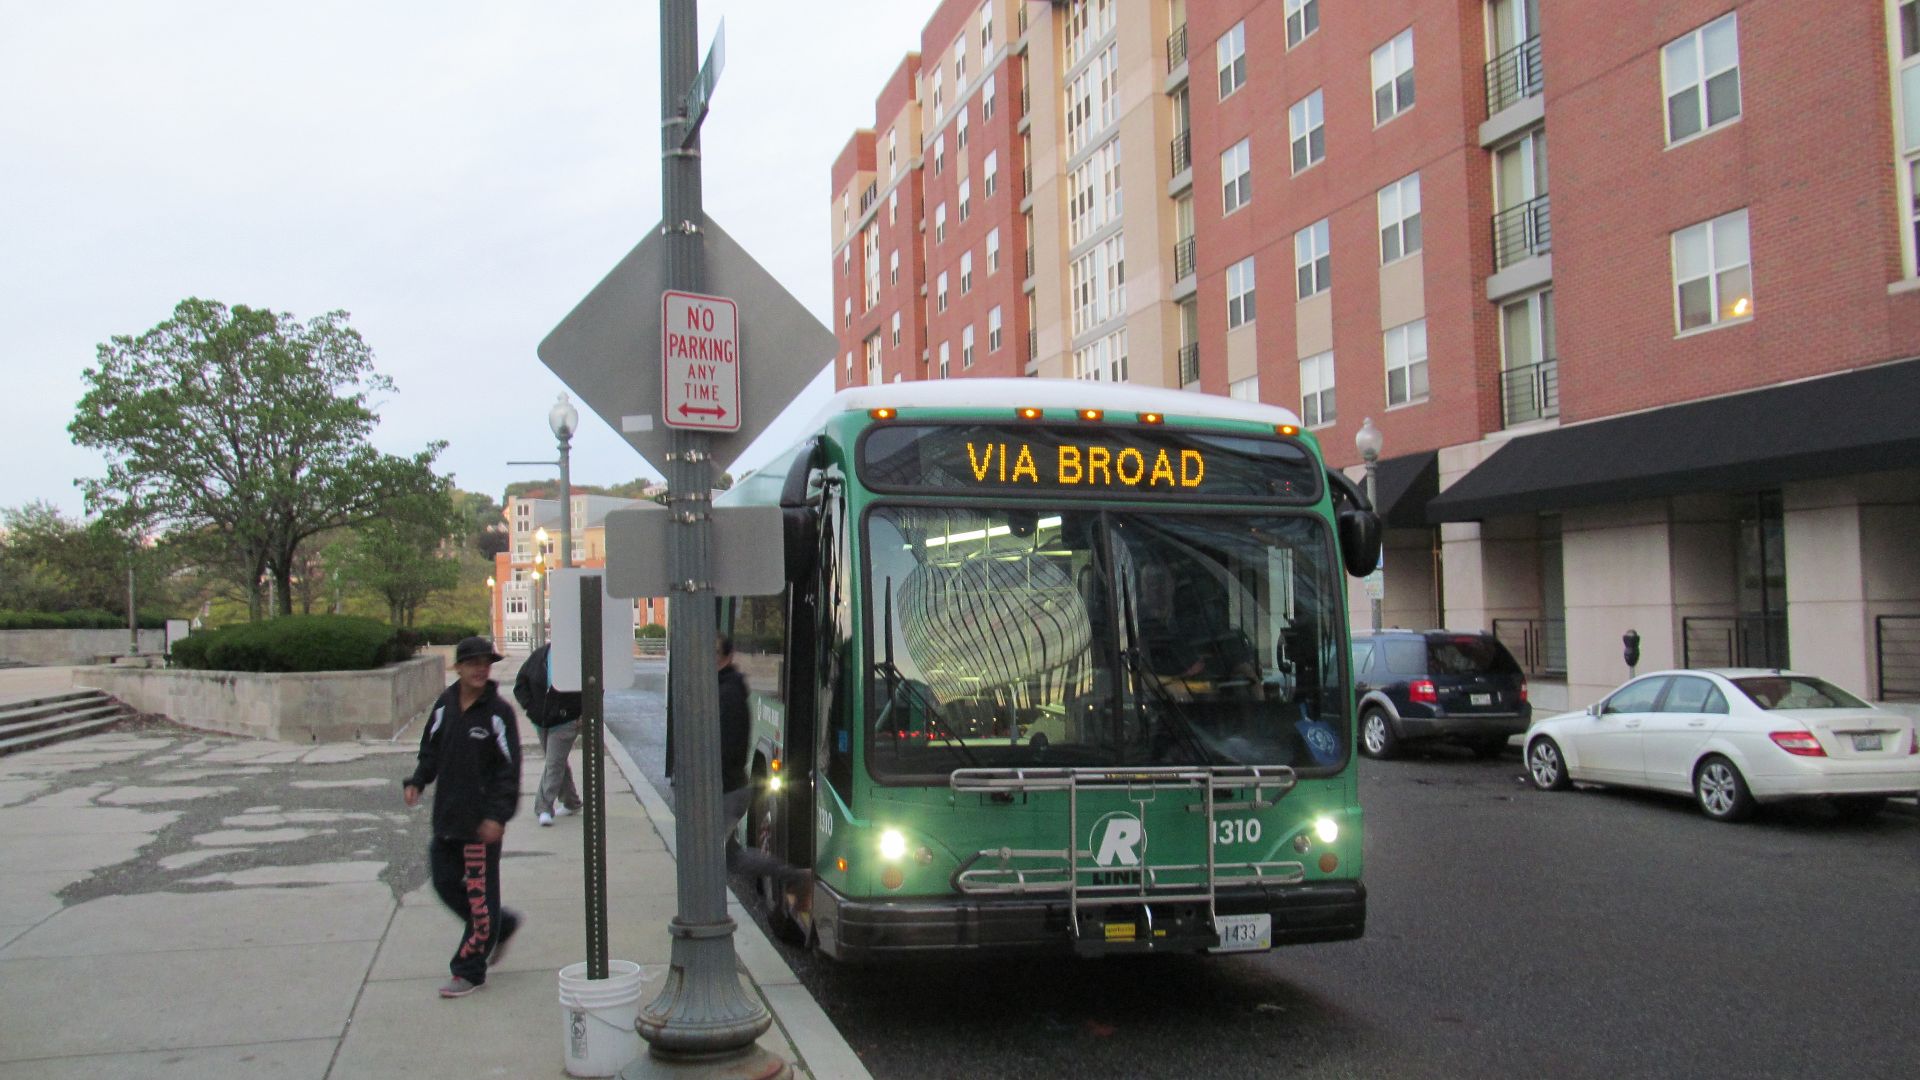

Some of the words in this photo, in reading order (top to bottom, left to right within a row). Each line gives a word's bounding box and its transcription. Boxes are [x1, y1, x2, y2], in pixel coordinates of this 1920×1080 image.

[687, 305, 714, 332] NO
[669, 333, 733, 363] PARKING
[687, 363, 716, 381] ANY
[685, 382, 720, 401] TIME
[967, 442, 1038, 483] VIA
[1058, 445, 1204, 488] BROAD
[1096, 818, 1142, 866] R
[1225, 922, 1256, 942] 1433
